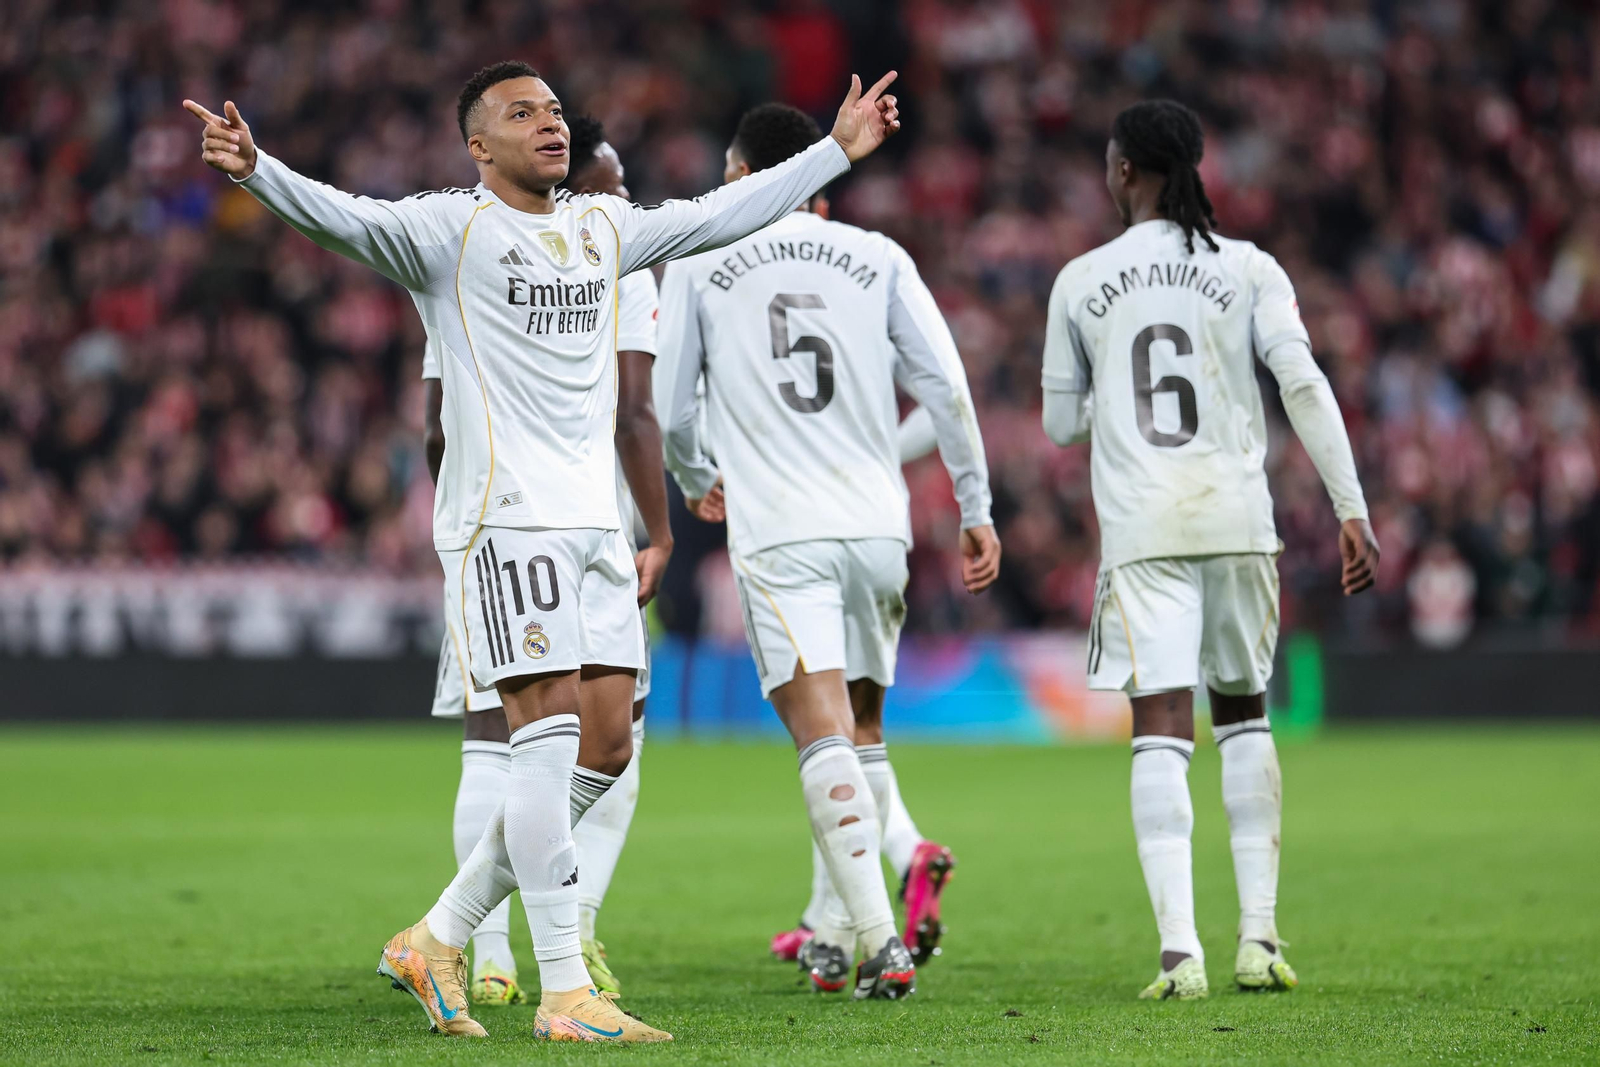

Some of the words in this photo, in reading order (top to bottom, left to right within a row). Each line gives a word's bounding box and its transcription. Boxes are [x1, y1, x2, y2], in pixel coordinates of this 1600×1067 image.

[507, 277, 605, 307] Emirates
[710, 240, 878, 292] BELLINGHAM
[1087, 263, 1236, 318] CAMAVINGA
[526, 311, 554, 335] FLY
[558, 308, 598, 334] BETTER
[768, 293, 834, 414] 5
[1131, 323, 1199, 448] 6
[501, 555, 560, 616] 10
